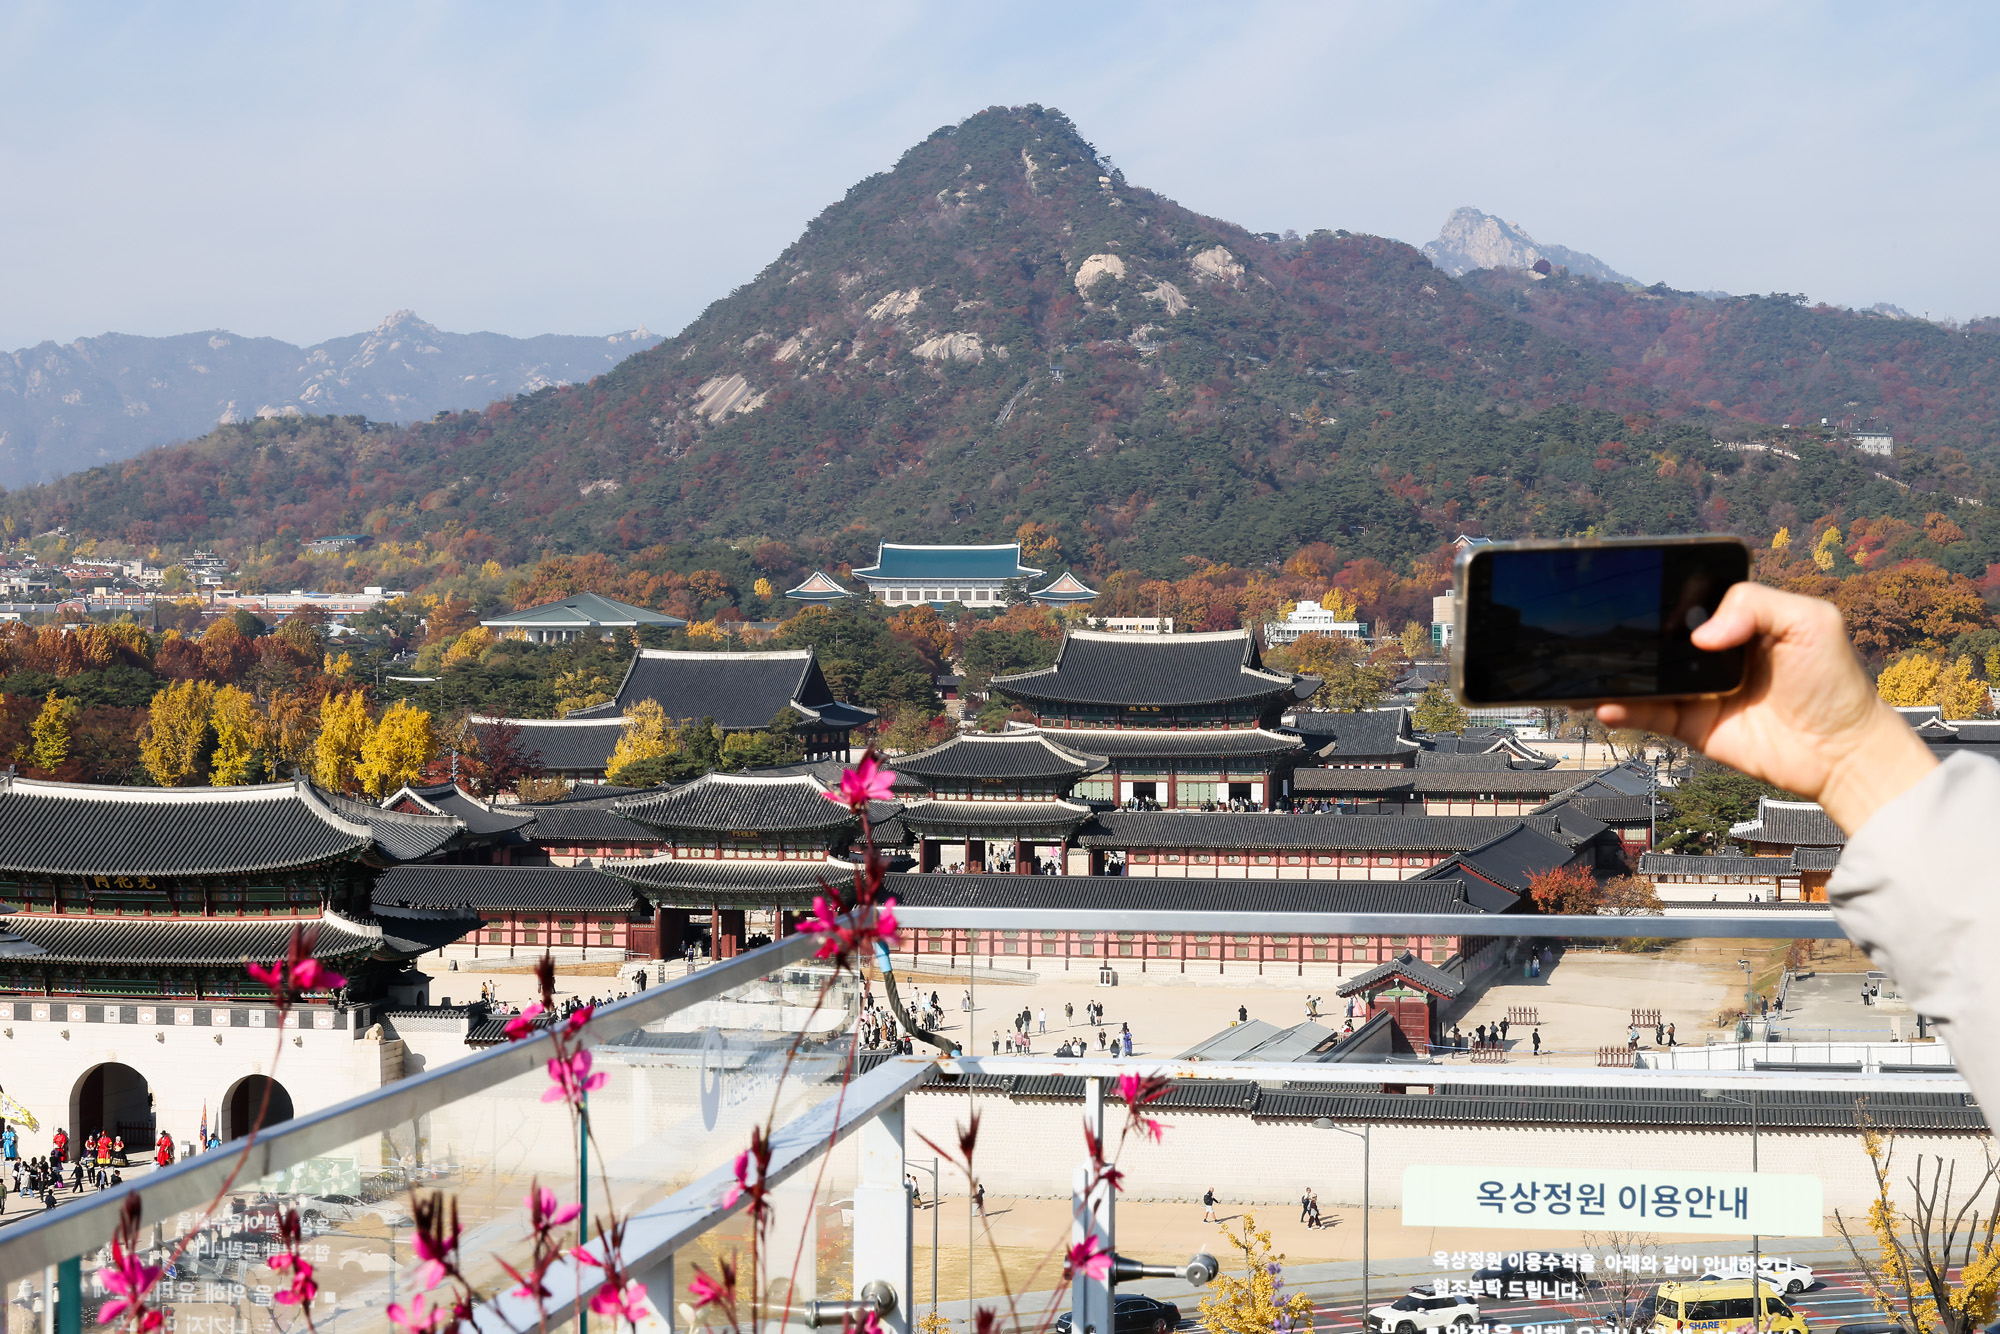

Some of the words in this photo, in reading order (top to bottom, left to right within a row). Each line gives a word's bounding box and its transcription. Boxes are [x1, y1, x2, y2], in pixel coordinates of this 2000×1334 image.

[1476, 1180, 1606, 1216] 옥상정원
[1618, 1184, 1748, 1220] 이용안내
[1432, 1251, 1502, 1271] 옥상정원
[1508, 1252, 1596, 1273] 이용수칙을
[1604, 1254, 1658, 1274] 아래와
[1663, 1255, 1697, 1274] 같이
[1703, 1255, 1792, 1275] 안내하오니
[1432, 1278, 1503, 1299] 협조부탁
[1508, 1280, 1584, 1301] 드립니다.
[1689, 1320, 1720, 1331] SHARE
